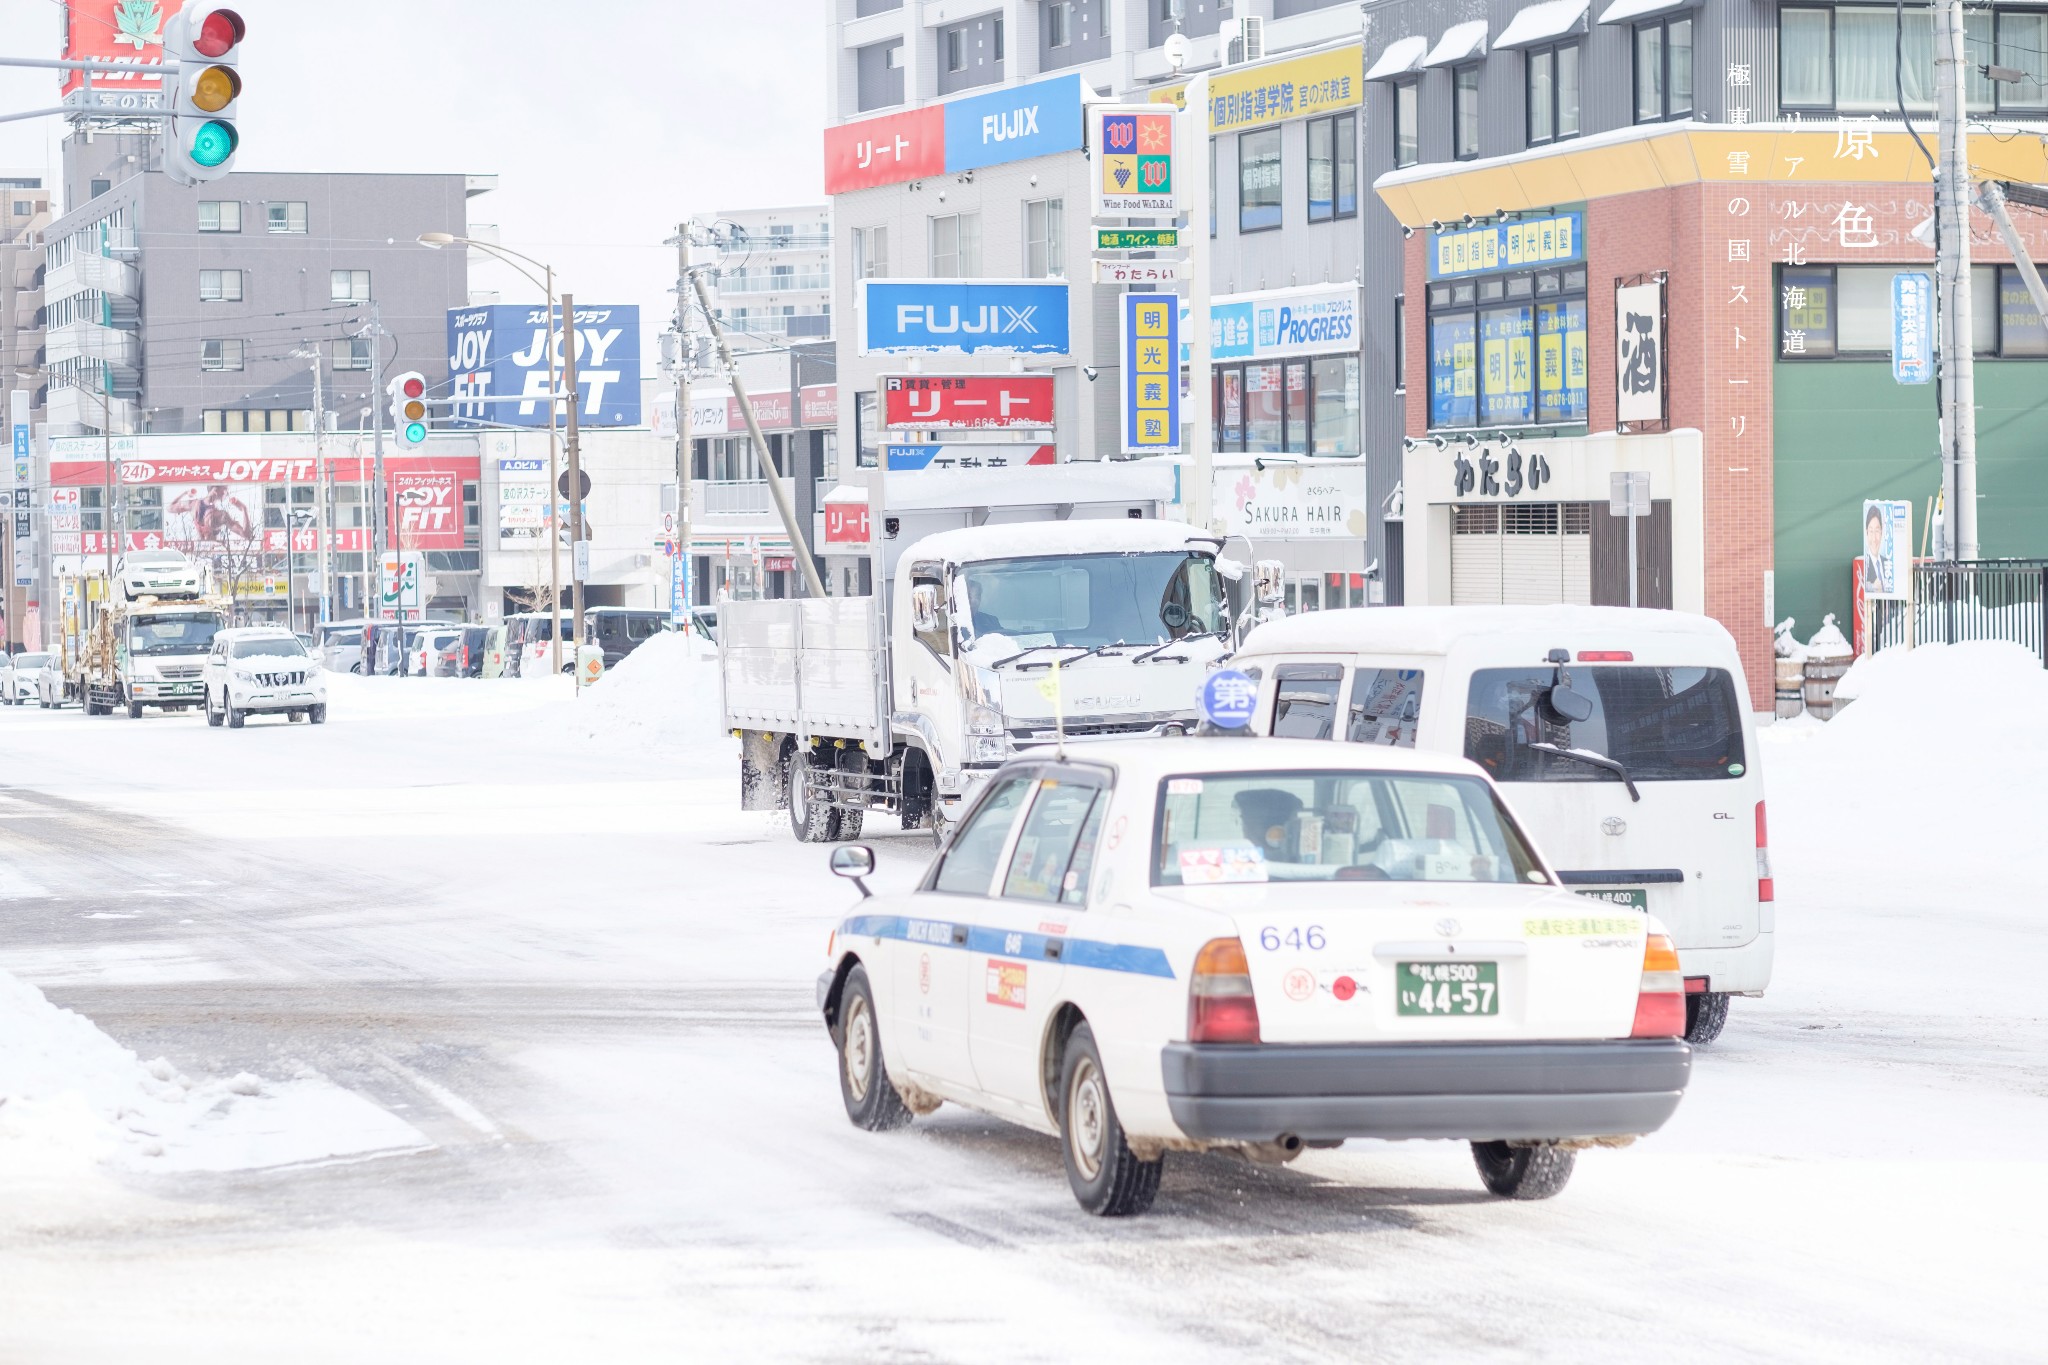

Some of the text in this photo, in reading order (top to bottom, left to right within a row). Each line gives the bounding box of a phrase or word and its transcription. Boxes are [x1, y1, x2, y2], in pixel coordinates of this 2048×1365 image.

[1300, 76, 1351, 107] 宮の沢教室
[982, 106, 1039, 144] FUJIX
[857, 135, 910, 169] リート
[1103, 199, 1121, 208] Wine
[1123, 199, 1141, 208] Food
[1101, 234, 1175, 246] 地酒・ワイン・焼酎
[1115, 269, 1174, 281] わたらい
[526, 310, 612, 324] スポークラブ
[897, 304, 1039, 334] FUJIX
[1277, 306, 1353, 345] PROGRESS
[450, 329, 493, 371] JOY
[512, 328, 623, 367] JOY
[1143, 311, 1163, 437] 明光義塾
[1489, 346, 1584, 382] 明光義塾
[453, 371, 492, 418] FIT
[519, 370, 621, 415] FIT
[905, 379, 966, 390] 賃貸・管理
[909, 390, 1030, 417] リート
[1489, 395, 1528, 410] 宮の沢教室
[889, 448, 925, 456] FUJIX
[122, 459, 313, 481] 24h フィットネス JOY FIT
[398, 476, 452, 486] 24h フィットネス
[1454, 447, 1551, 498] わたらい
[503, 486, 562, 500] 宮の沢ステーシ
[1306, 486, 1341, 496] さくらヘアー
[402, 506, 452, 529] FIT
[831, 511, 870, 534] リート
[1245, 501, 1342, 524] SAKURA HAIR
[1073, 693, 1141, 710] ISUZU
[1713, 812, 1735, 820] GL
[1261, 925, 1326, 951] 646
[1402, 982, 1496, 1014] い 44-57
